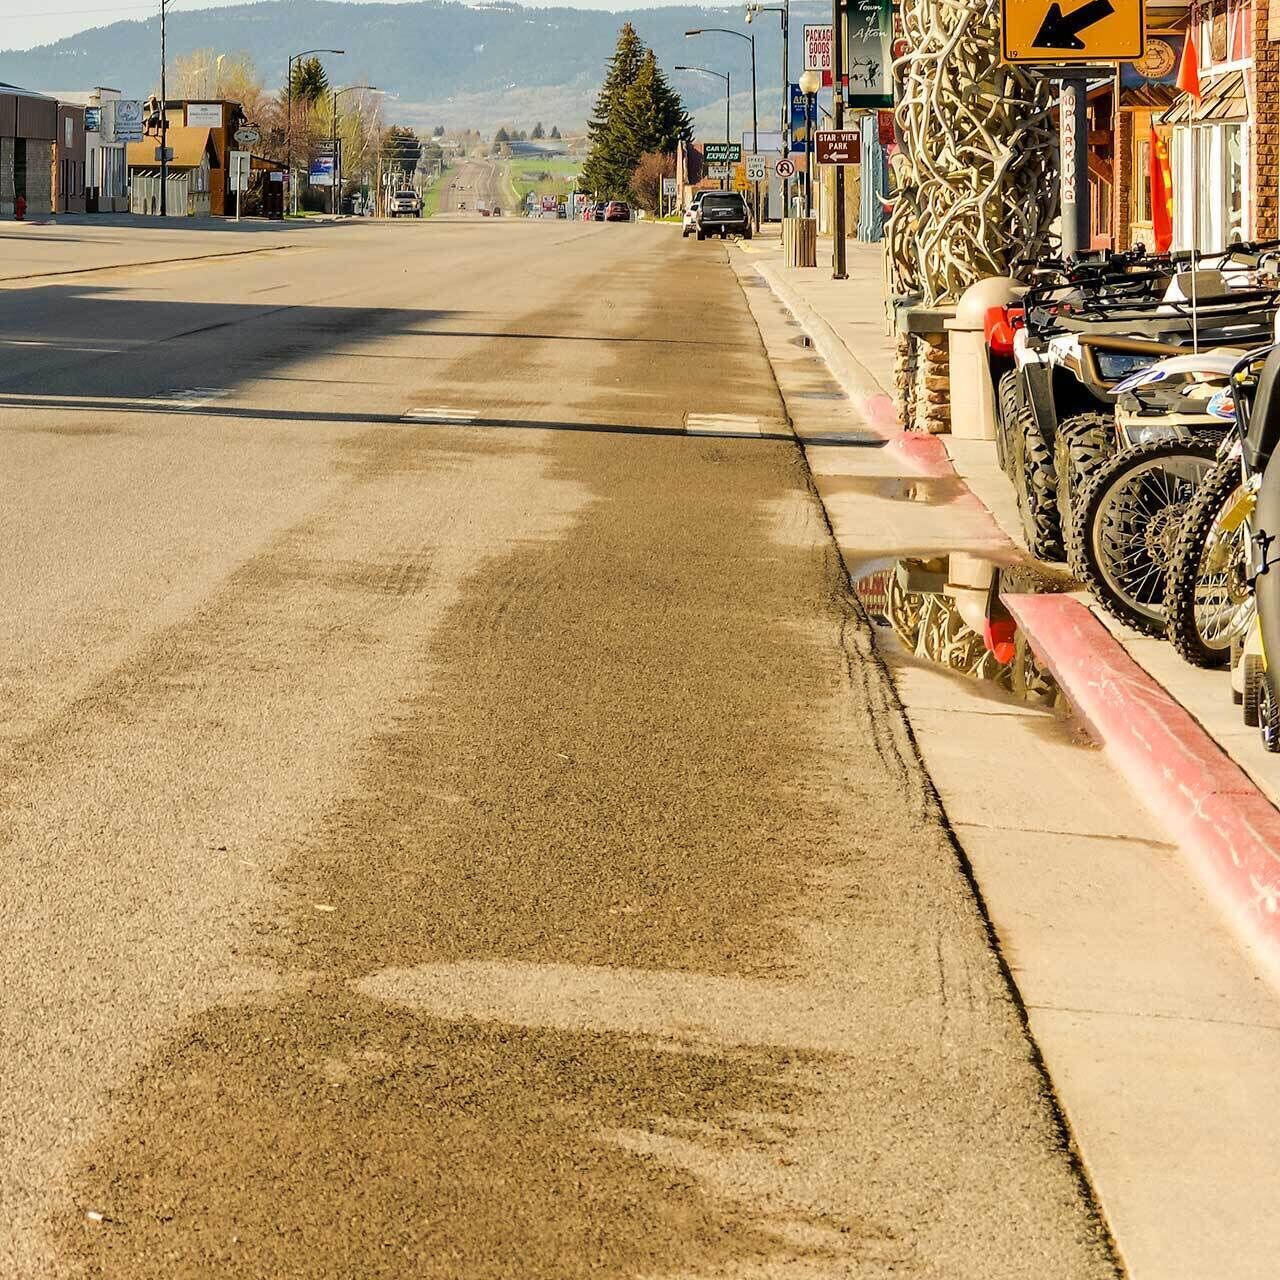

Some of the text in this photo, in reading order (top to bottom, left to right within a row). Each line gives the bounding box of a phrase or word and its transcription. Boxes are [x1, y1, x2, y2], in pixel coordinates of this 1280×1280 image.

[858, 0, 883, 11] Town
[865, 12, 877, 26] of
[852, 27, 888, 43] Afton
[809, 42, 830, 55] GOODS
[809, 54, 831, 67] TO GO
[818, 133, 858, 142] STAR VIEW
[828, 142, 848, 150] PARK
[1064, 110, 1075, 202] PARKING
[748, 169, 764, 178] 30
